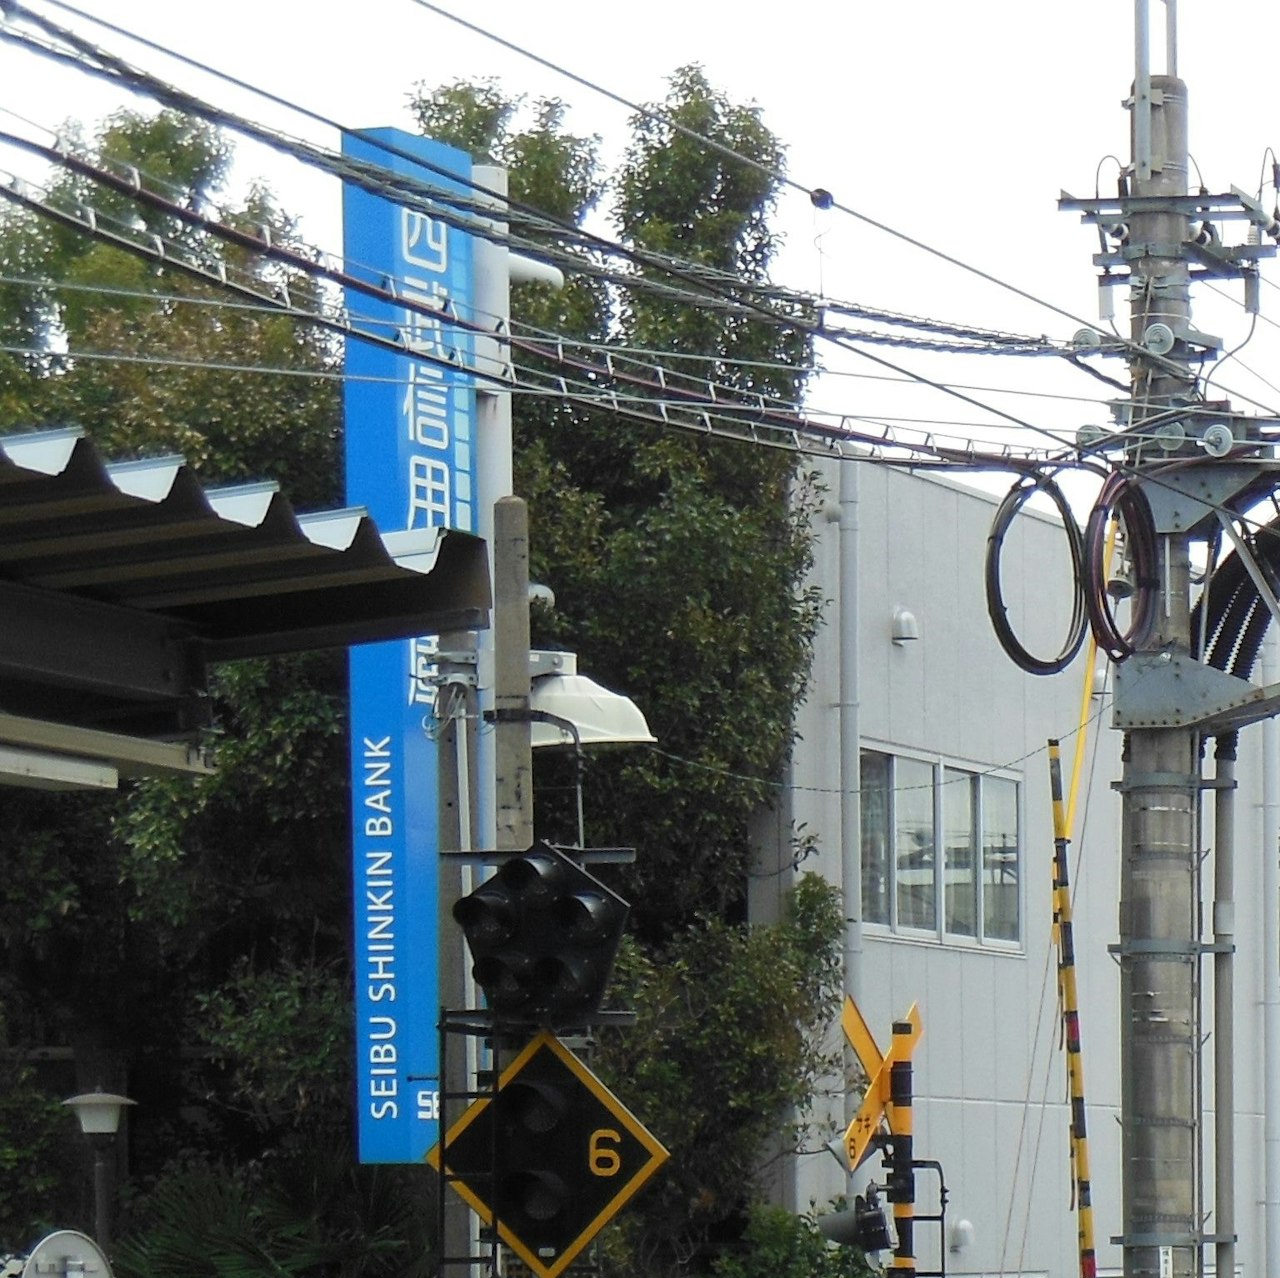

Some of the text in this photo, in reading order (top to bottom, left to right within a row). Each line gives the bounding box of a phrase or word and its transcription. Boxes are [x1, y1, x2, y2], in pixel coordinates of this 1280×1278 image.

[364, 735, 398, 1119] SEIBU SHINKIN BANK
[589, 1128, 621, 1177] 6
